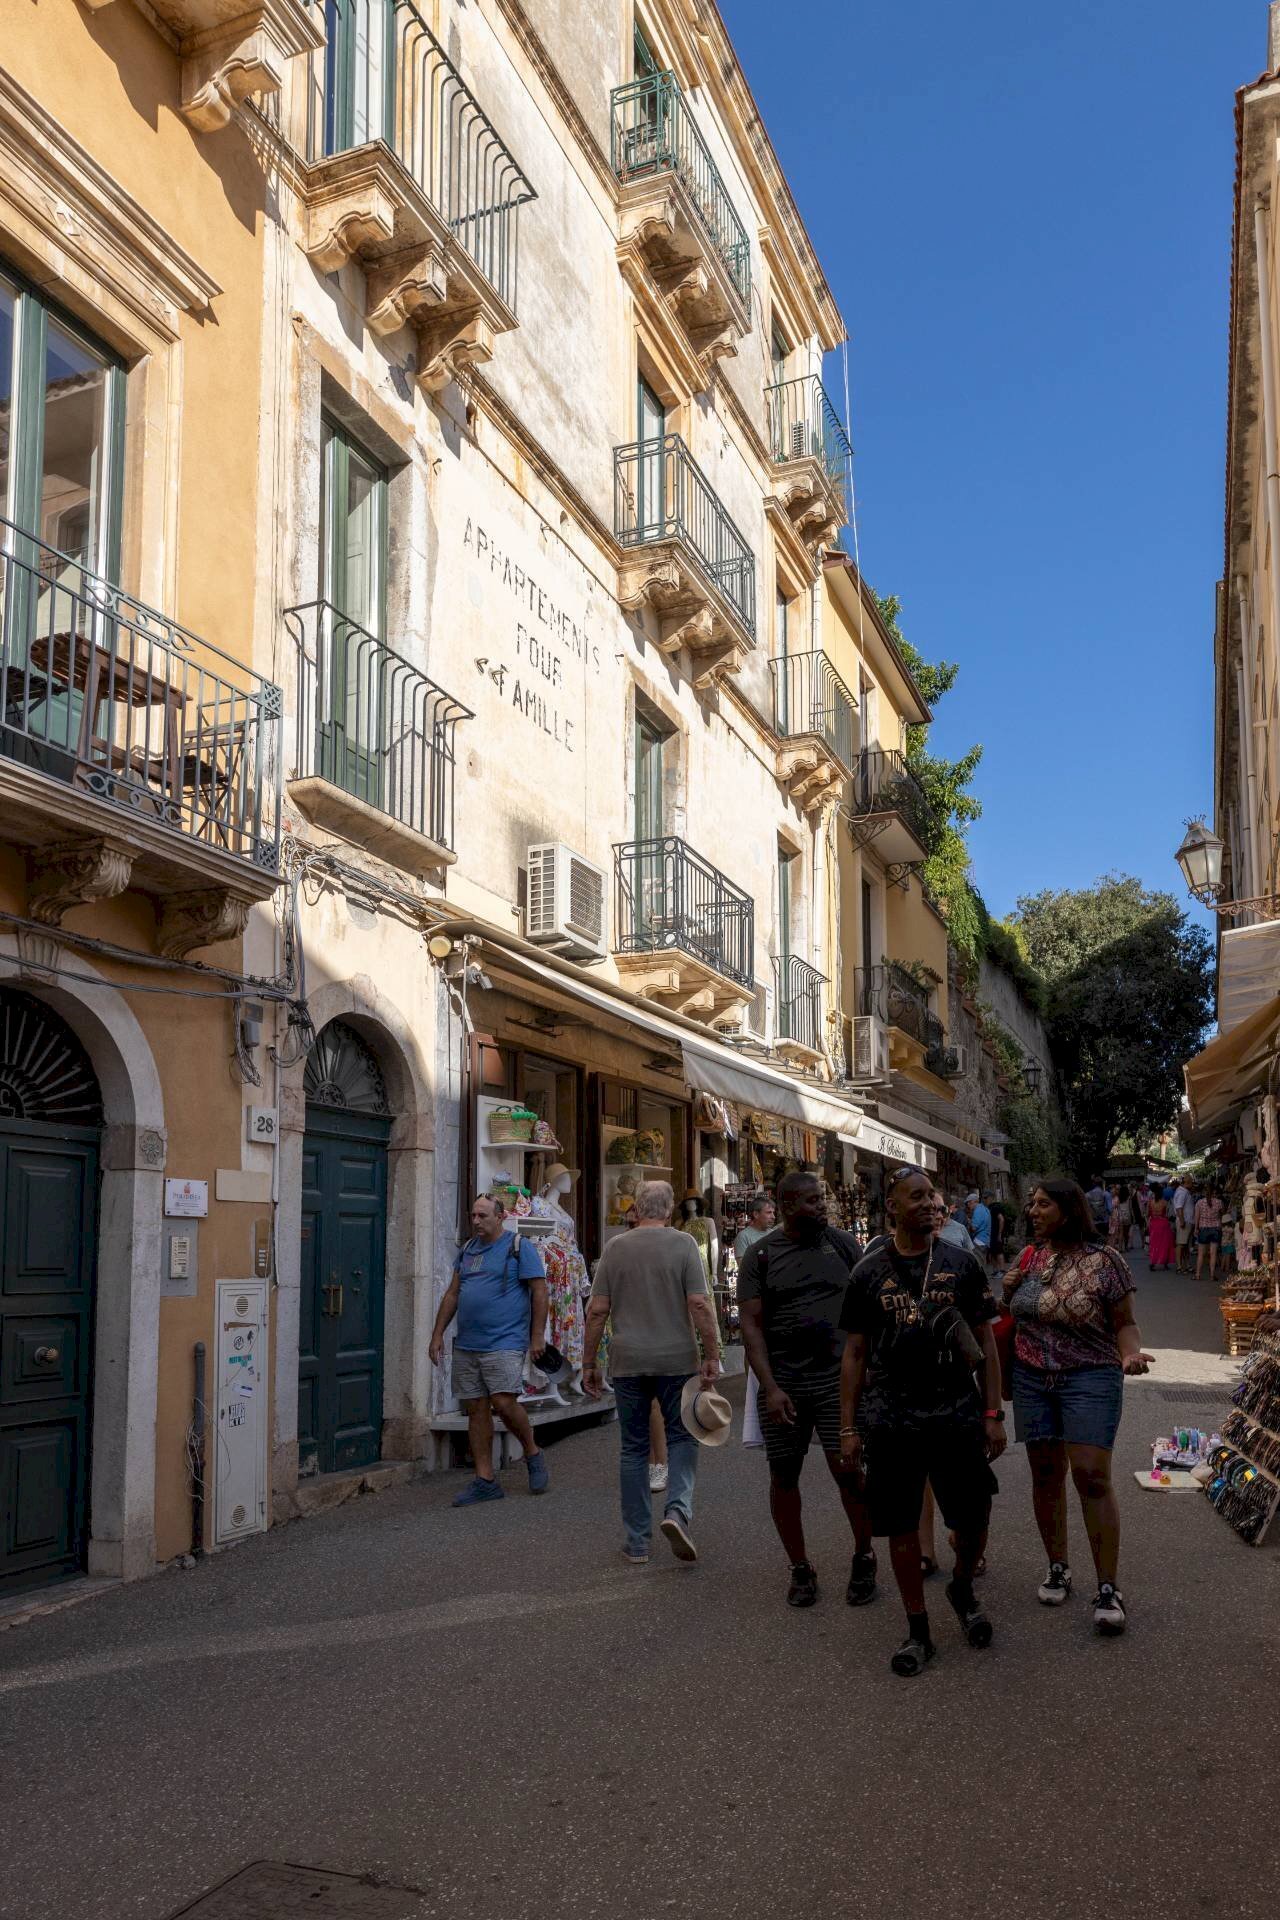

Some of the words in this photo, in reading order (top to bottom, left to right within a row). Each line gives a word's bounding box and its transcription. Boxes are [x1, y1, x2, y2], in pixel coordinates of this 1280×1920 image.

[516, 622, 563, 690] POUR
[497, 663, 576, 753] FAMILLE
[257, 1115, 274, 1134] 28
